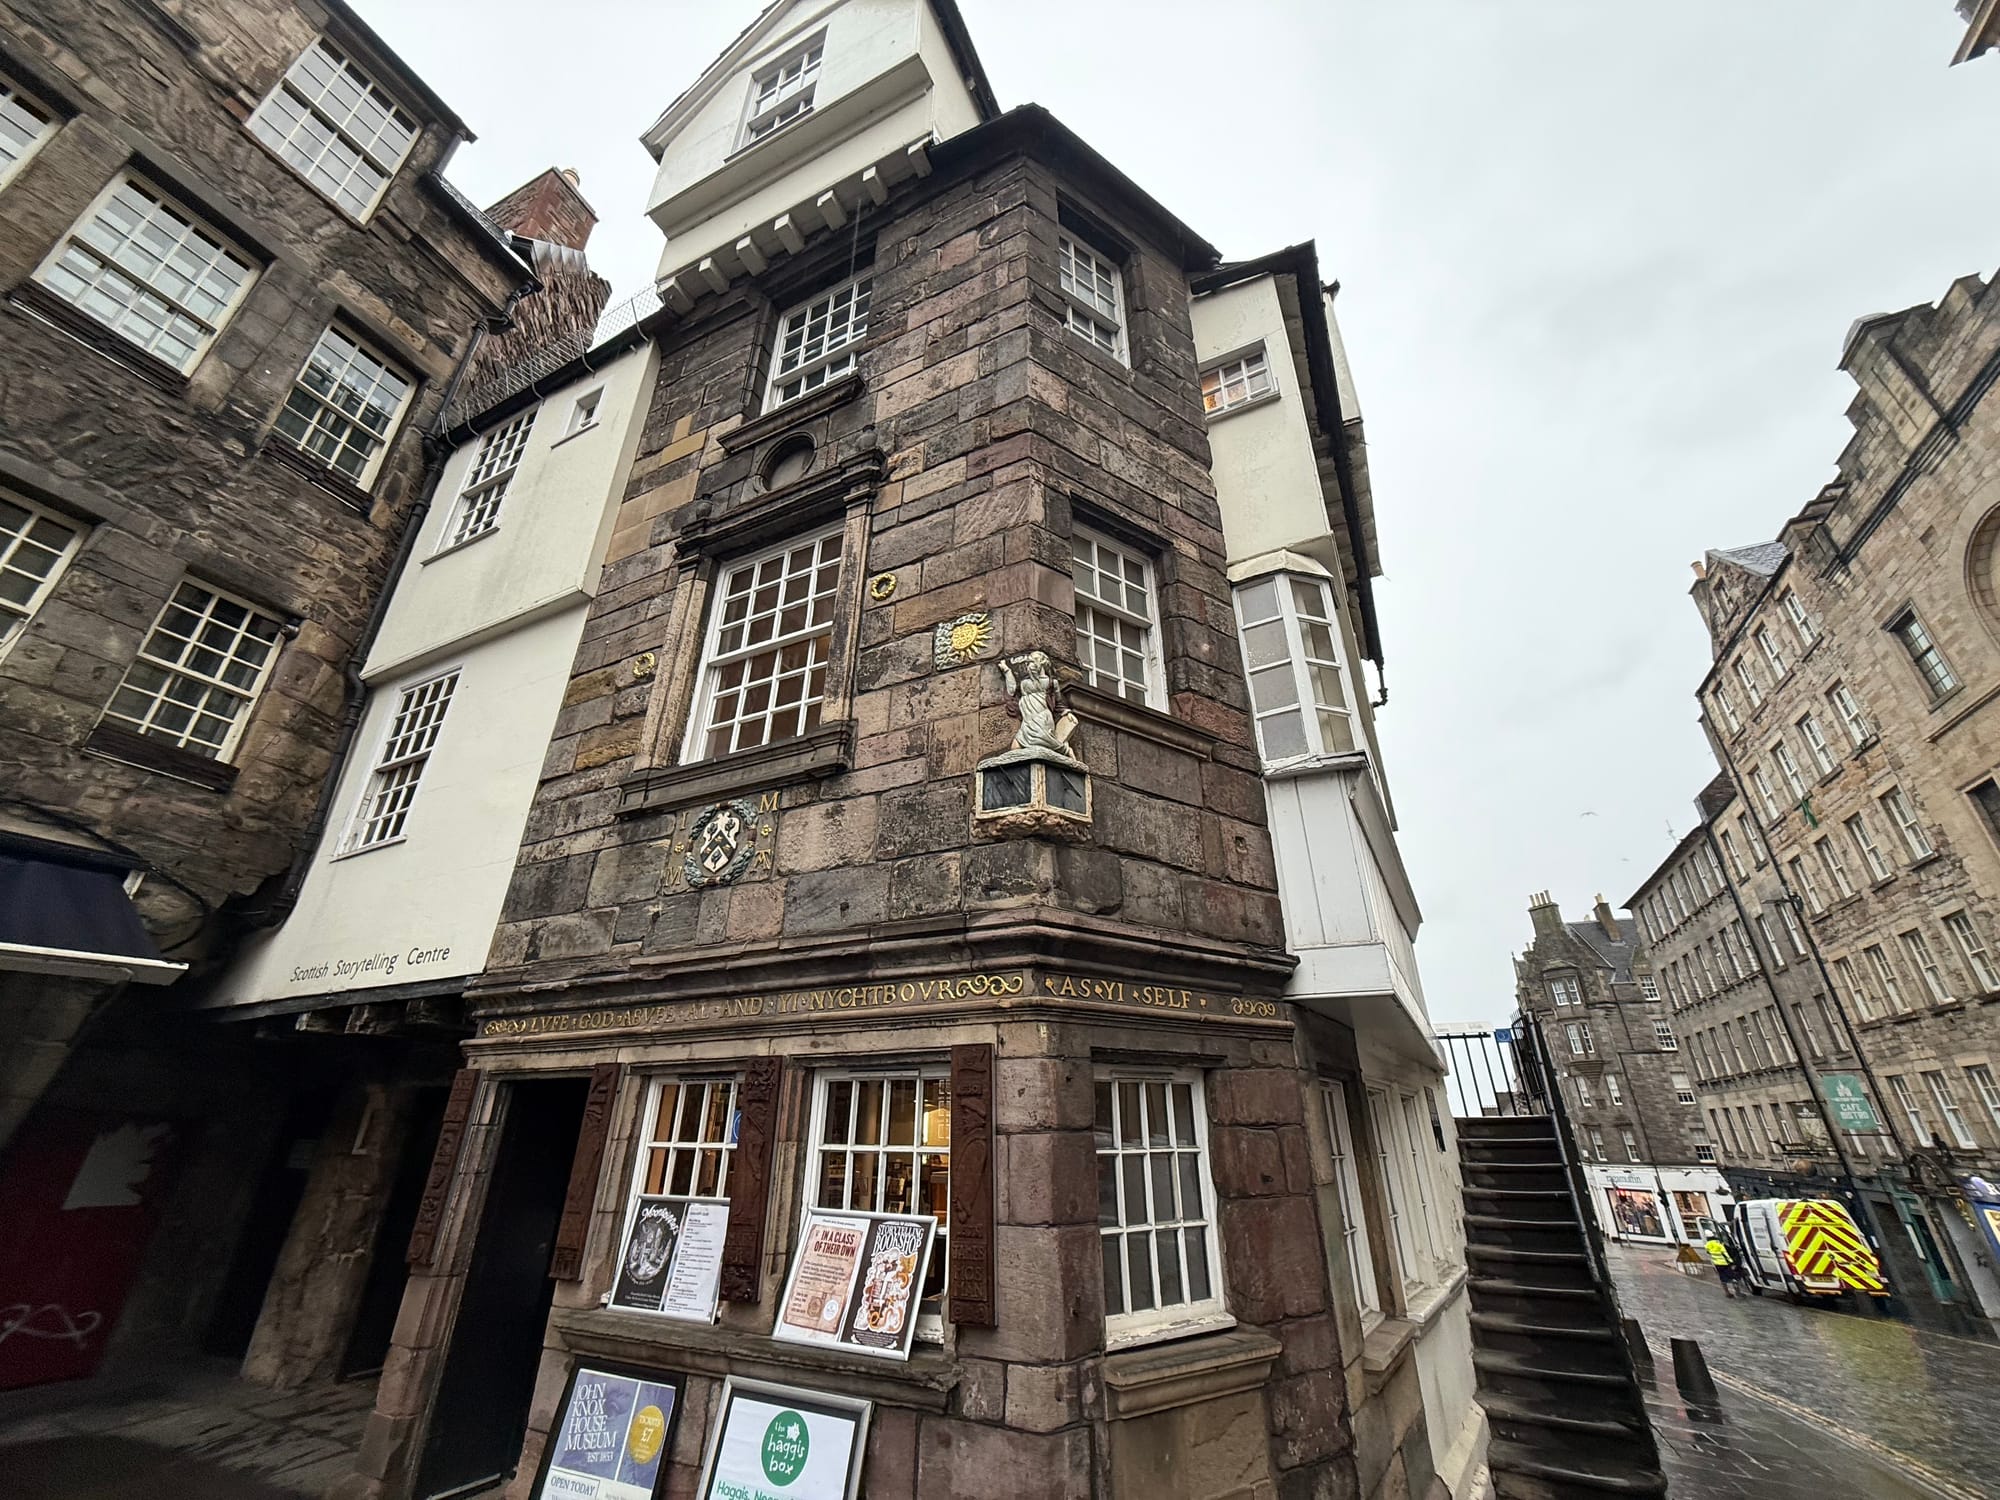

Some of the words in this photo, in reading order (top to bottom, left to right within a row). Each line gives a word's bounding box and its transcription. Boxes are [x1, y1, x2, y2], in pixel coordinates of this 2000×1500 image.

[758, 791, 780, 815] M
[664, 866, 682, 887] M
[290, 961, 329, 982] Scottish
[333, 952, 399, 980] Storytelling
[407, 946, 450, 966] Centre
[1060, 976, 1091, 998] AS
[1101, 980, 1125, 1001] YI
[1142, 986, 1193, 1009] SELF
[529, 1014, 569, 1033] LVFE
[578, 1010, 614, 1029] GOD
[719, 997, 762, 1018] AND
[778, 992, 799, 1013] YI
[821, 1229, 829, 1241] IN
[828, 1232, 833, 1242] A
[834, 1232, 855, 1246] CLASS
[877, 1223, 924, 1240] STORYTELLING
[814, 1240, 822, 1252] OF
[822, 1241, 840, 1255] THEIR
[840, 1244, 856, 1258] OWN
[871, 1232, 922, 1257] BOOKSHOP
[576, 1382, 607, 1400] JOHN
[572, 1398, 607, 1417] KNOX
[568, 1414, 608, 1434] HOUSE
[564, 1431, 617, 1451] MUSEUM
[767, 1433, 805, 1461] haggis
[769, 1455, 794, 1475] box
[550, 1477, 570, 1490] OPEN
[570, 1480, 595, 1497] TODAY
